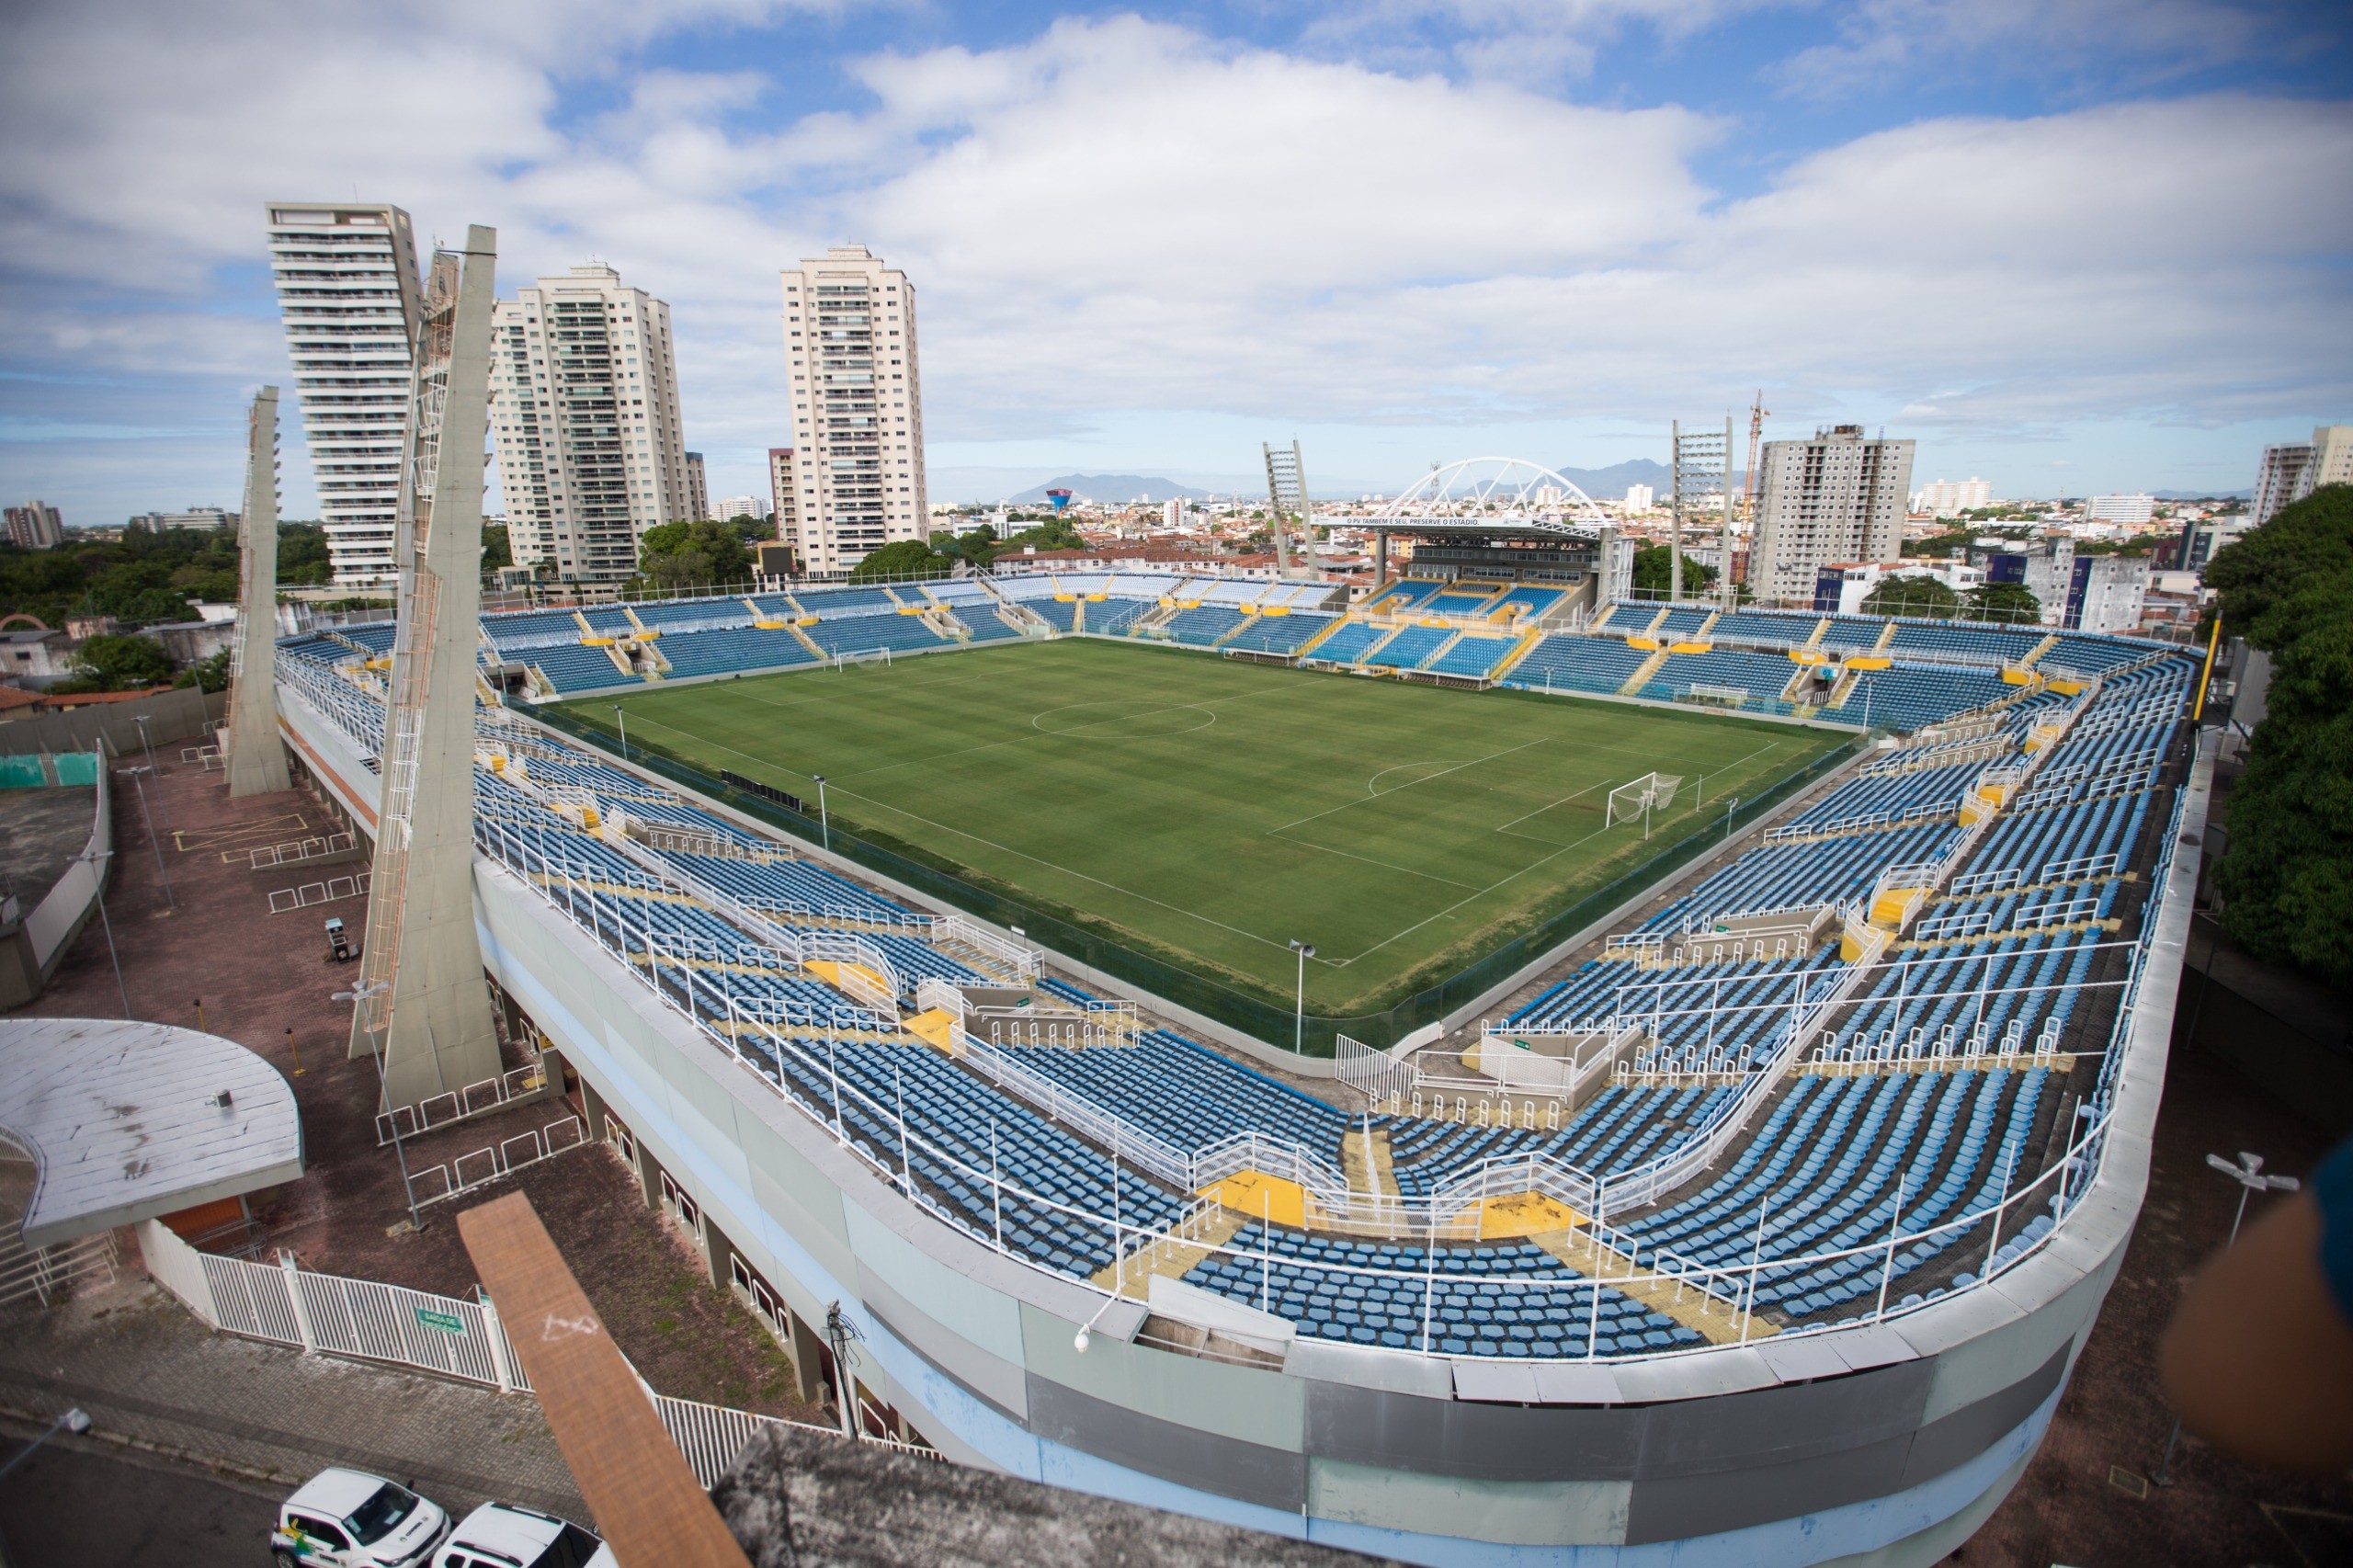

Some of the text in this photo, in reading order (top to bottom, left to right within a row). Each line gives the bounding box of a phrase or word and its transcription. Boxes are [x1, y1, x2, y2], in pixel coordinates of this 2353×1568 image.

[1449, 517, 1480, 526] ESTÁDIO.
[425, 1312, 457, 1326] SAÍDA DE
